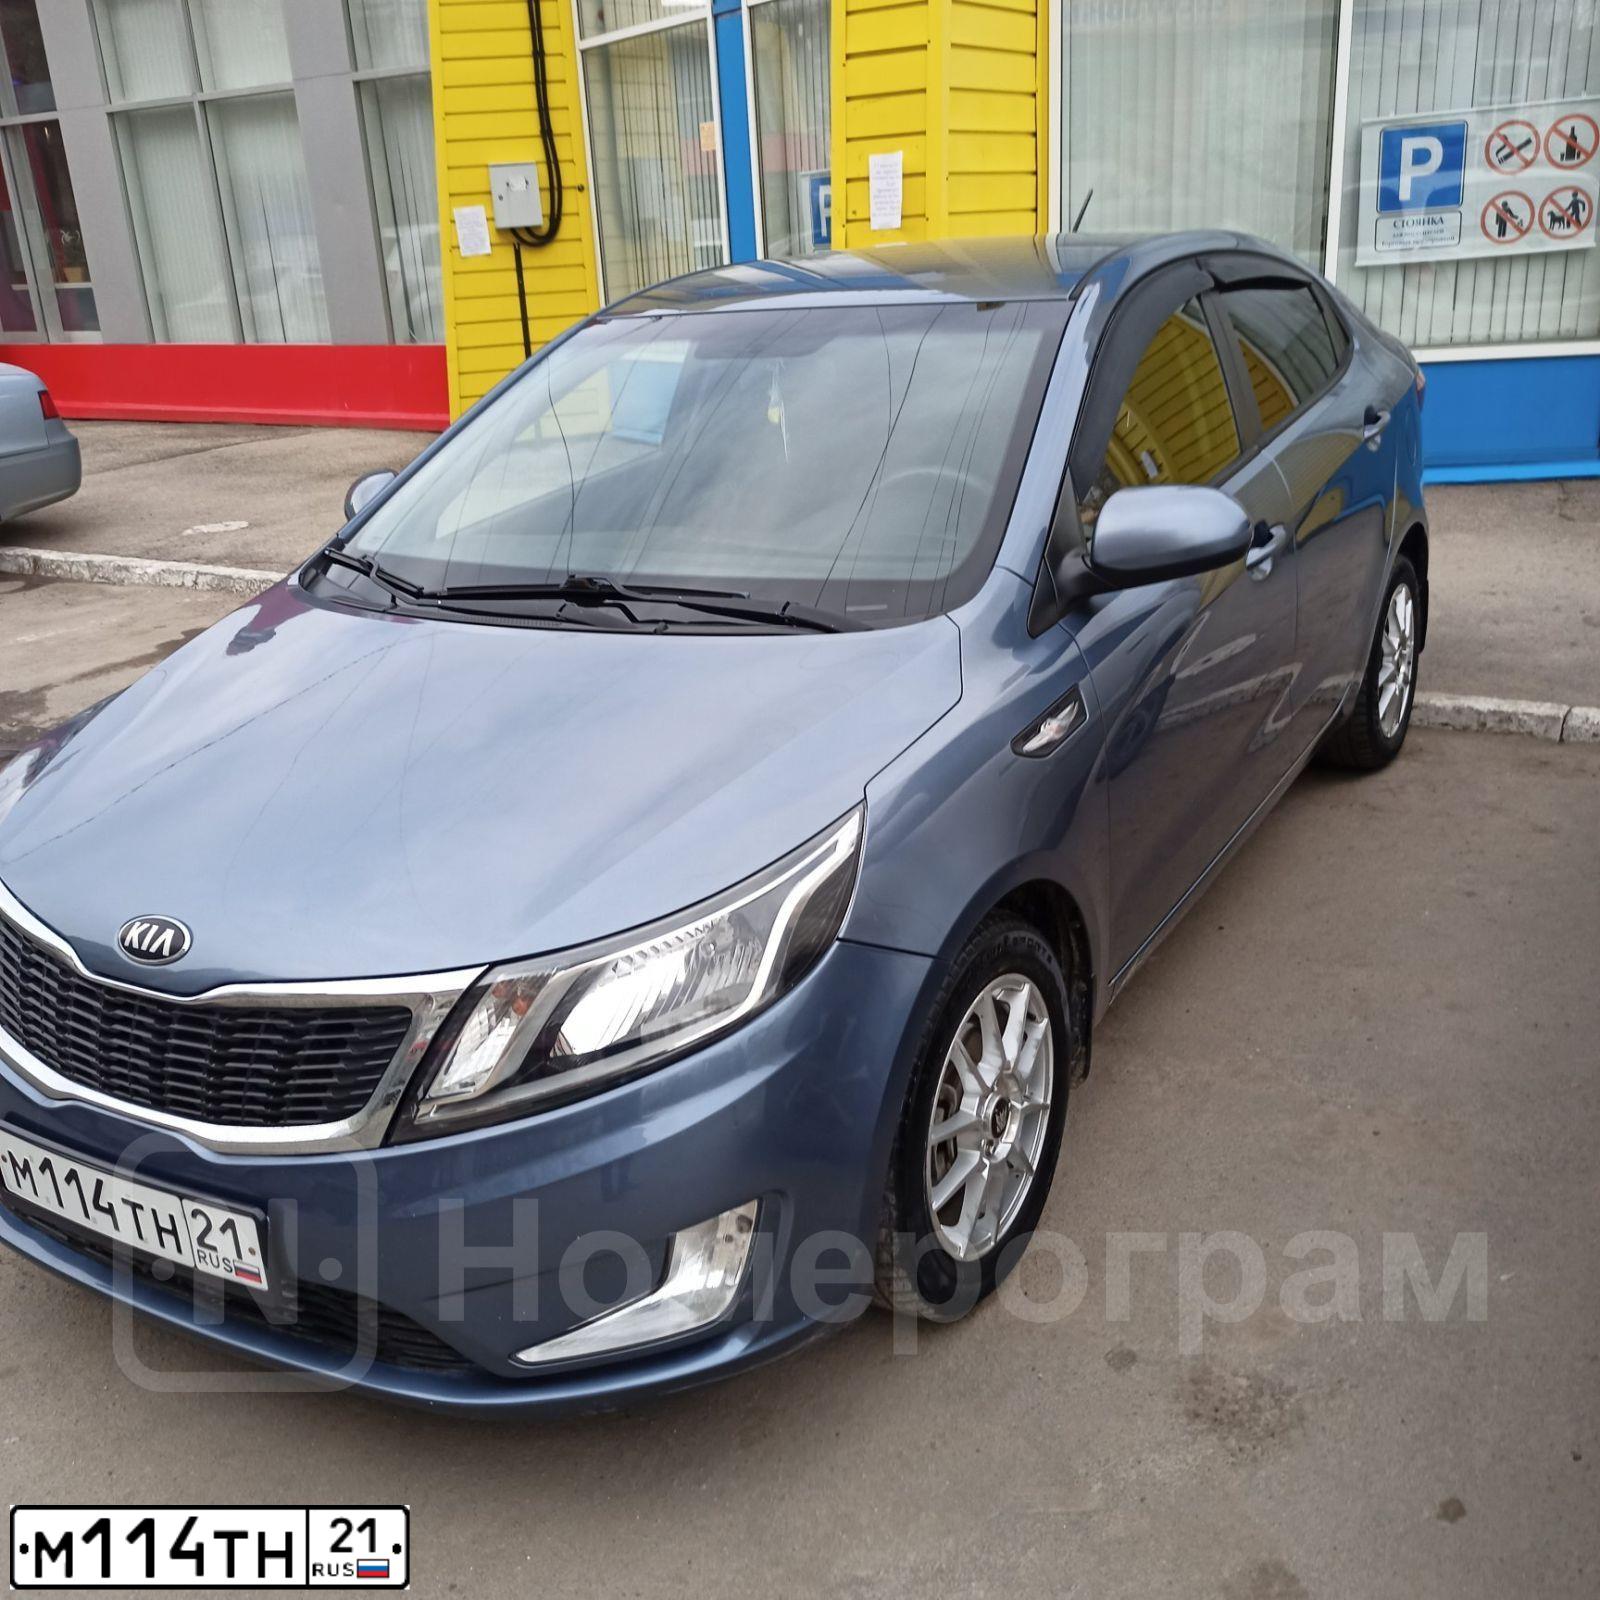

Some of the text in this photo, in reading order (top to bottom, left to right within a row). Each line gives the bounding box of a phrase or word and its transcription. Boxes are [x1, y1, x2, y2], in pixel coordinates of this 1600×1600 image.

[1399, 136, 1443, 201] P
[1393, 215, 1444, 228] СТОЯНКА
[124, 921, 175, 956] KIA
[191, 1208, 243, 1260] 21
[198, 1249, 233, 1274] RUS
